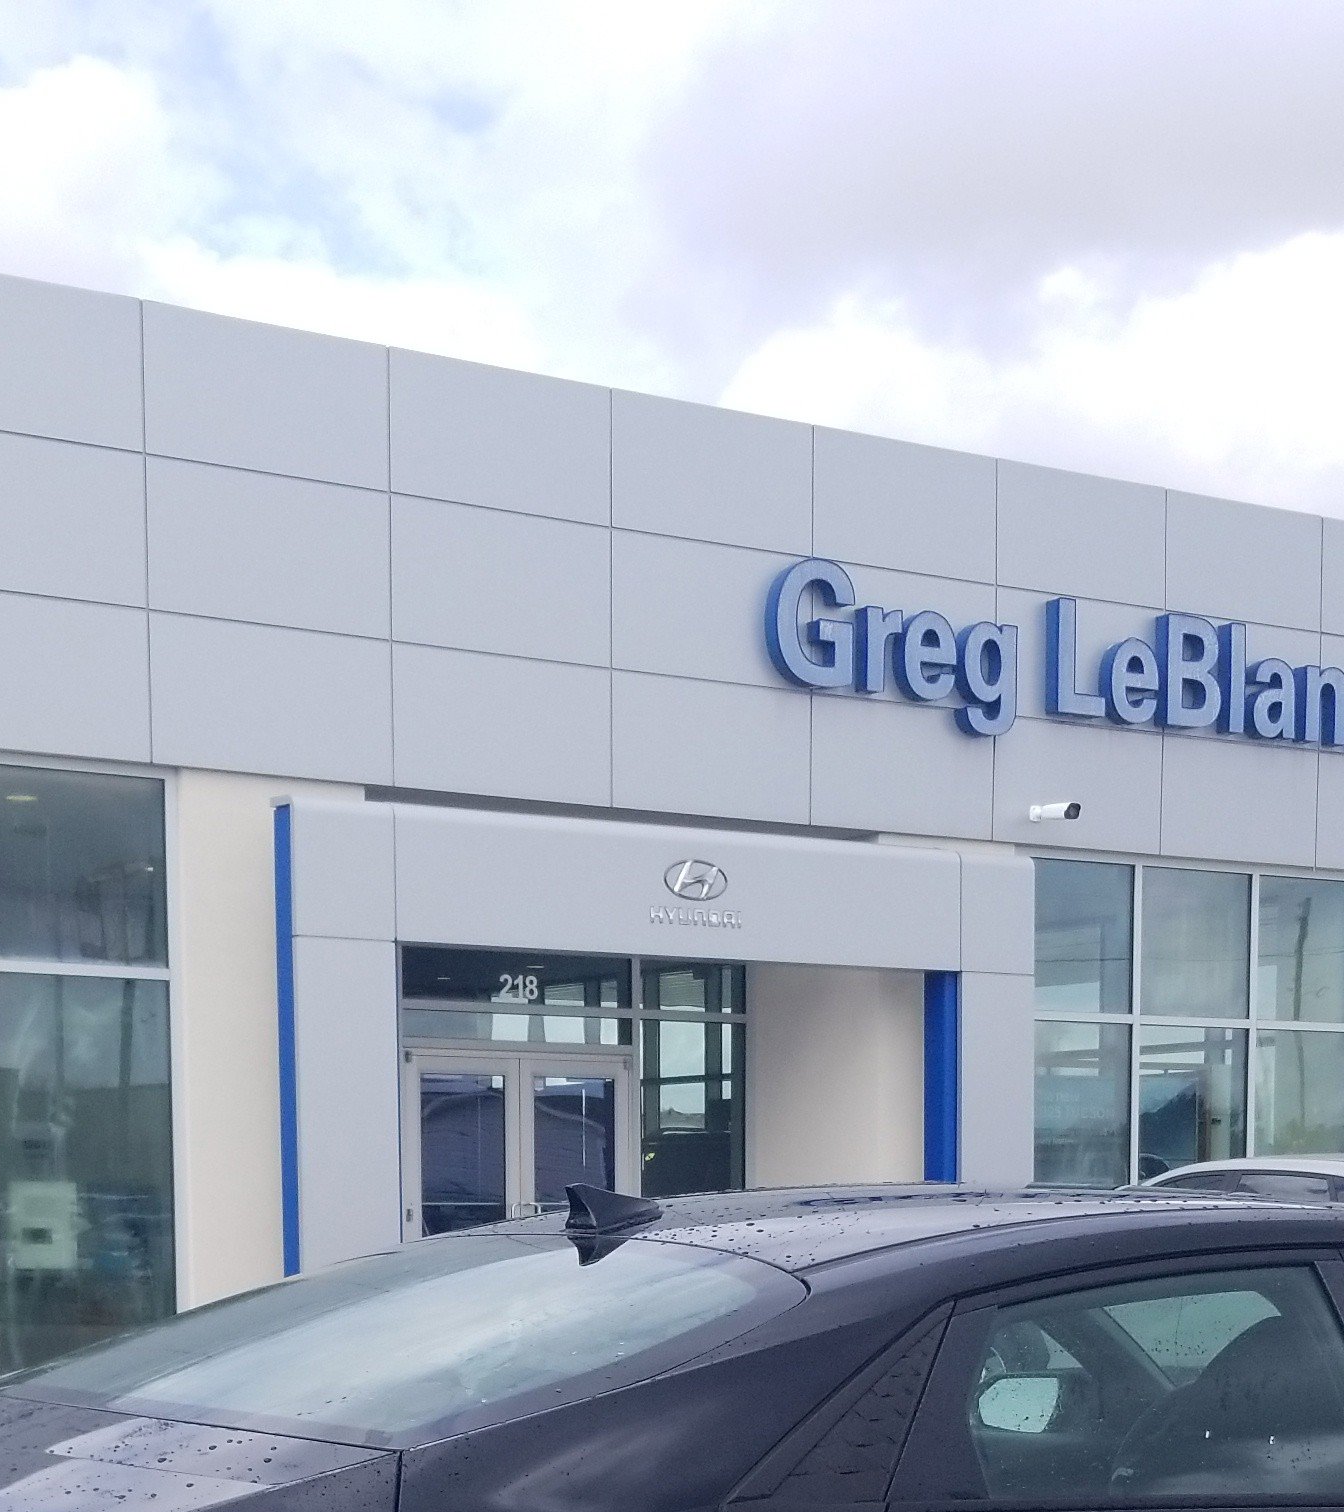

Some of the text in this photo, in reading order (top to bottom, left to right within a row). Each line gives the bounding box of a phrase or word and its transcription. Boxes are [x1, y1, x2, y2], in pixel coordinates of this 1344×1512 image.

[764, 558, 1019, 737] Greg
[649, 906, 742, 929] HYUNDAI
[499, 974, 538, 1000] 218
